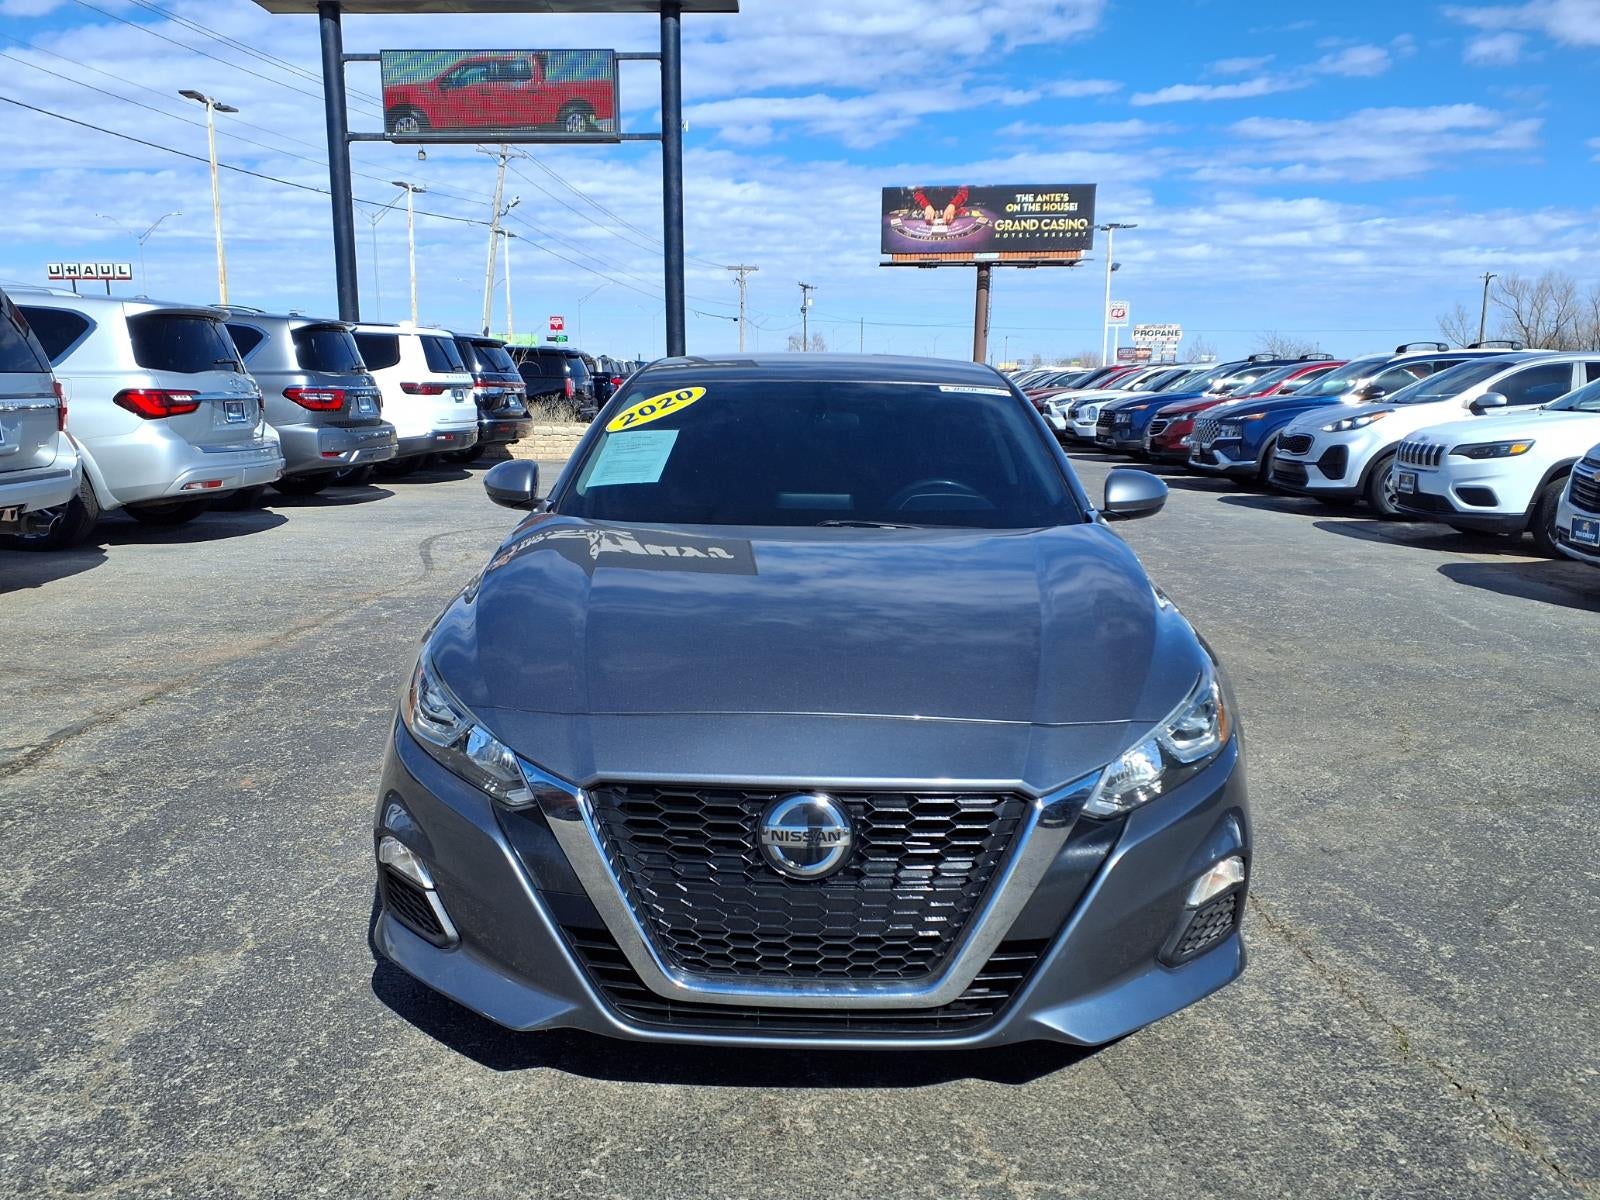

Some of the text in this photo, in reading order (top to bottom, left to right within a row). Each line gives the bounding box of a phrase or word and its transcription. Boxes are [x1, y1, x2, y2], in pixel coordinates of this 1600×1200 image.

[1016, 193, 1069, 202] THE ANTE'S
[1006, 202, 1078, 212] ON THE HOUSE!
[994, 218, 1088, 231] GRAND CASINO
[1112, 309, 1124, 317] 66
[1133, 329, 1181, 337] PROPANE
[619, 390, 694, 427] 2020
[771, 830, 841, 842] NISSAN
